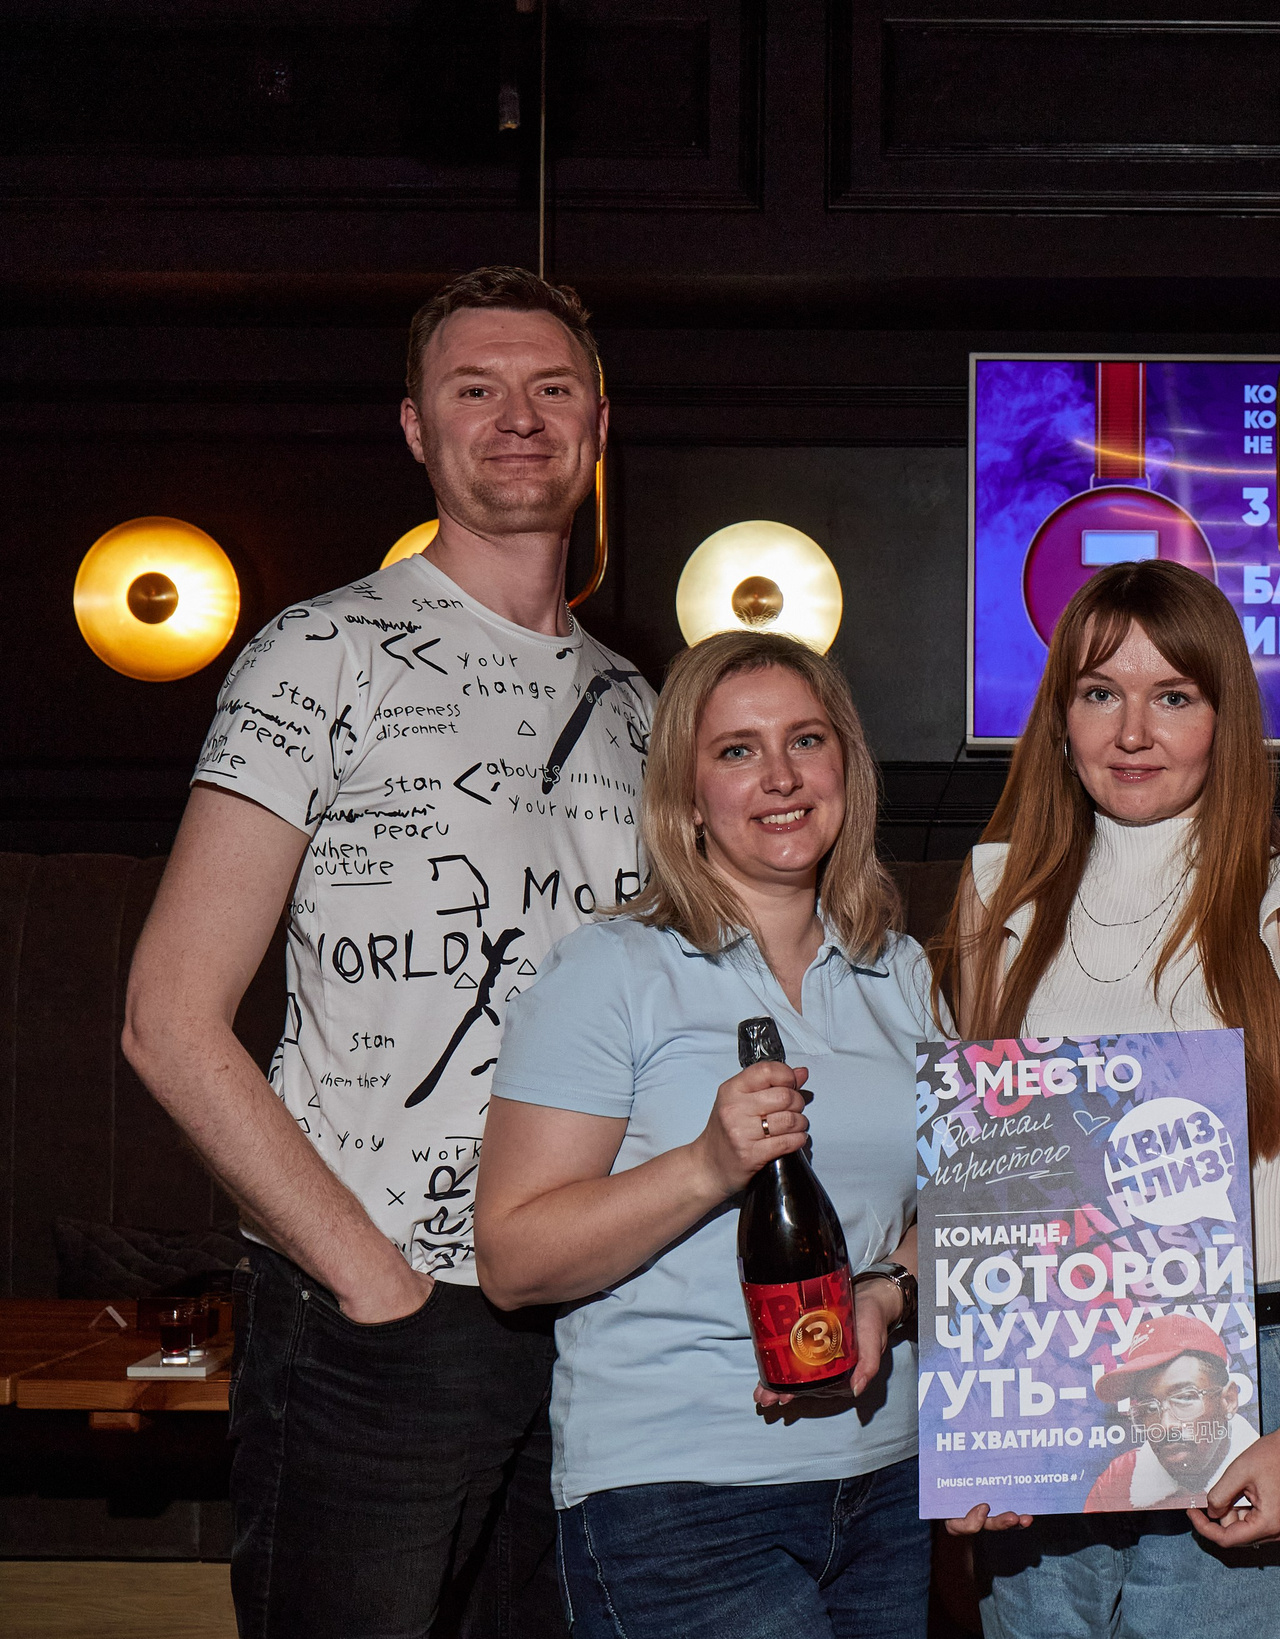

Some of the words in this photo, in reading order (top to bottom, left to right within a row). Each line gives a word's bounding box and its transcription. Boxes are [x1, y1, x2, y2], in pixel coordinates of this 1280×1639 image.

[1244, 435, 1273, 454] НЕ
[1241, 487, 1271, 527] 3
[412, 598, 464, 612] stan
[457, 652, 518, 669] your
[463, 676, 556, 699] change
[272, 681, 327, 720] stan
[384, 776, 442, 798] stan
[508, 795, 557, 815] your
[565, 805, 636, 825] world
[310, 837, 368, 860] when
[349, 1032, 395, 1052] stan
[356, 1072, 391, 1089] they
[933, 1062, 961, 1100] 3
[975, 1054, 1143, 1098] МЕСТО
[934, 1145, 1072, 1193] игристого
[934, 1223, 1069, 1249] КОМАНДЕ,
[935, 1233, 1246, 1308] КОТОРОЙ
[805, 1320, 832, 1354] 3
[936, 1432, 966, 1452] НЕ
[970, 1426, 1084, 1451] ХВАТИЛО
[1089, 1424, 1126, 1448] ДО
[936, 1474, 974, 1489] [MUSIC
[975, 1473, 1012, 1487] PARTY]
[1013, 1473, 1032, 1485] 100
[1033, 1472, 1069, 1485] ХИТОВ
